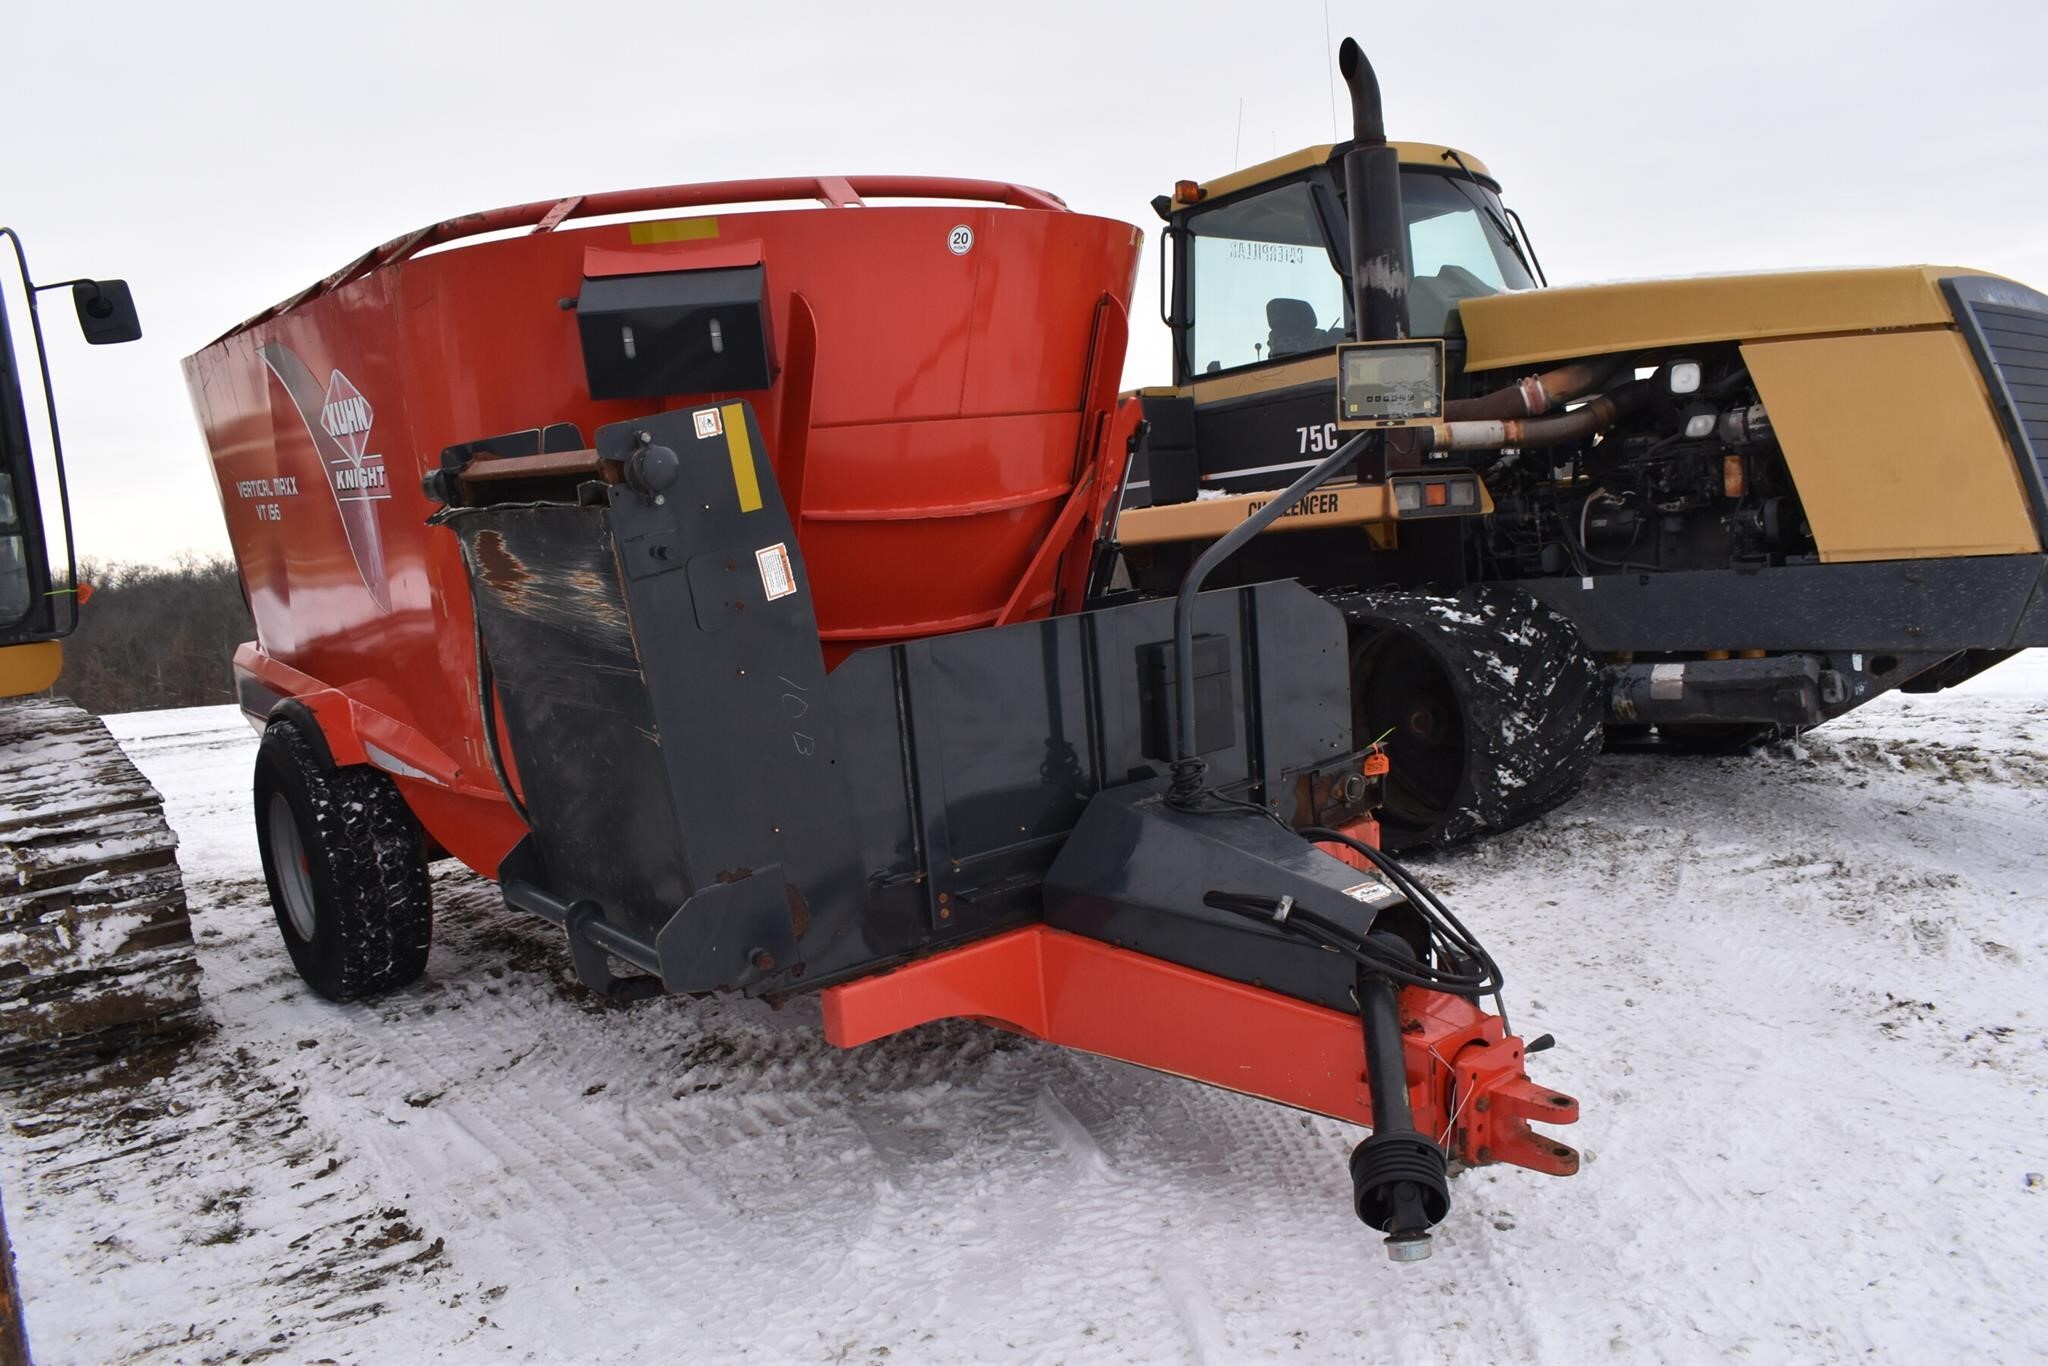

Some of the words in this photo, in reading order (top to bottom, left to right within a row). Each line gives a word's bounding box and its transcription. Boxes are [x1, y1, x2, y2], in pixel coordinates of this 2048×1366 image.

[953, 232, 969, 244] 20
[325, 396, 369, 437] KUHN
[1296, 422, 1338, 454] 75C
[236, 480, 274, 498] VERTICAL
[273, 476, 299, 496] MAXX
[335, 465, 385, 491] KNIGHT
